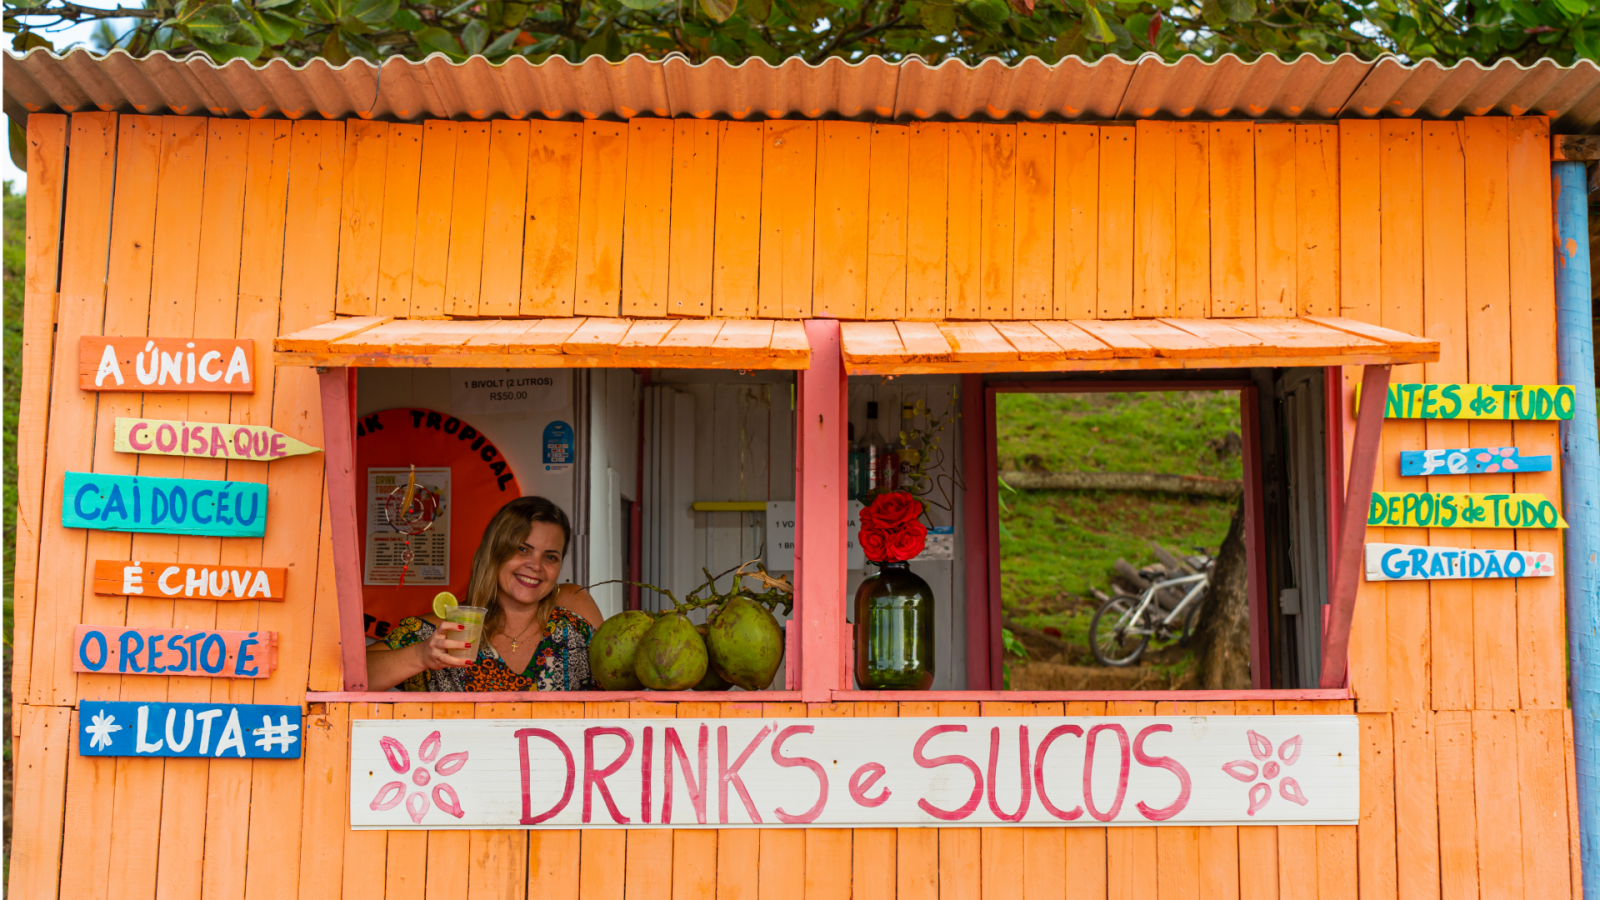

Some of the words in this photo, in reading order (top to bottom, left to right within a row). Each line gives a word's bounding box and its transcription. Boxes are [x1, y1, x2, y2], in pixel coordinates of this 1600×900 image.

[94, 344, 125, 387] A
[464, 381, 469, 389] 1
[471, 380, 505, 389] BIVOLT
[506, 378, 516, 389] (2
[516, 377, 554, 388] LITROS)
[1384, 383, 1463, 420] NTES
[1469, 386, 1498, 416] de
[1491, 384, 1575, 420] TUDO
[233, 427, 288, 459] QUE
[409, 410, 514, 492] TROPICAL
[151, 485, 188, 526] DO
[191, 481, 259, 527] CÉU
[1461, 497, 1487, 524] de
[1483, 494, 1559, 529] TUDO
[122, 561, 144, 595] É
[158, 565, 272, 598] CHUVA
[79, 630, 108, 672] O
[117, 630, 227, 674] RESTO
[234, 631, 260, 677] É
[135, 705, 247, 757] LUTA
[848, 762, 893, 808] e
[912, 723, 1192, 823] SUCOS
